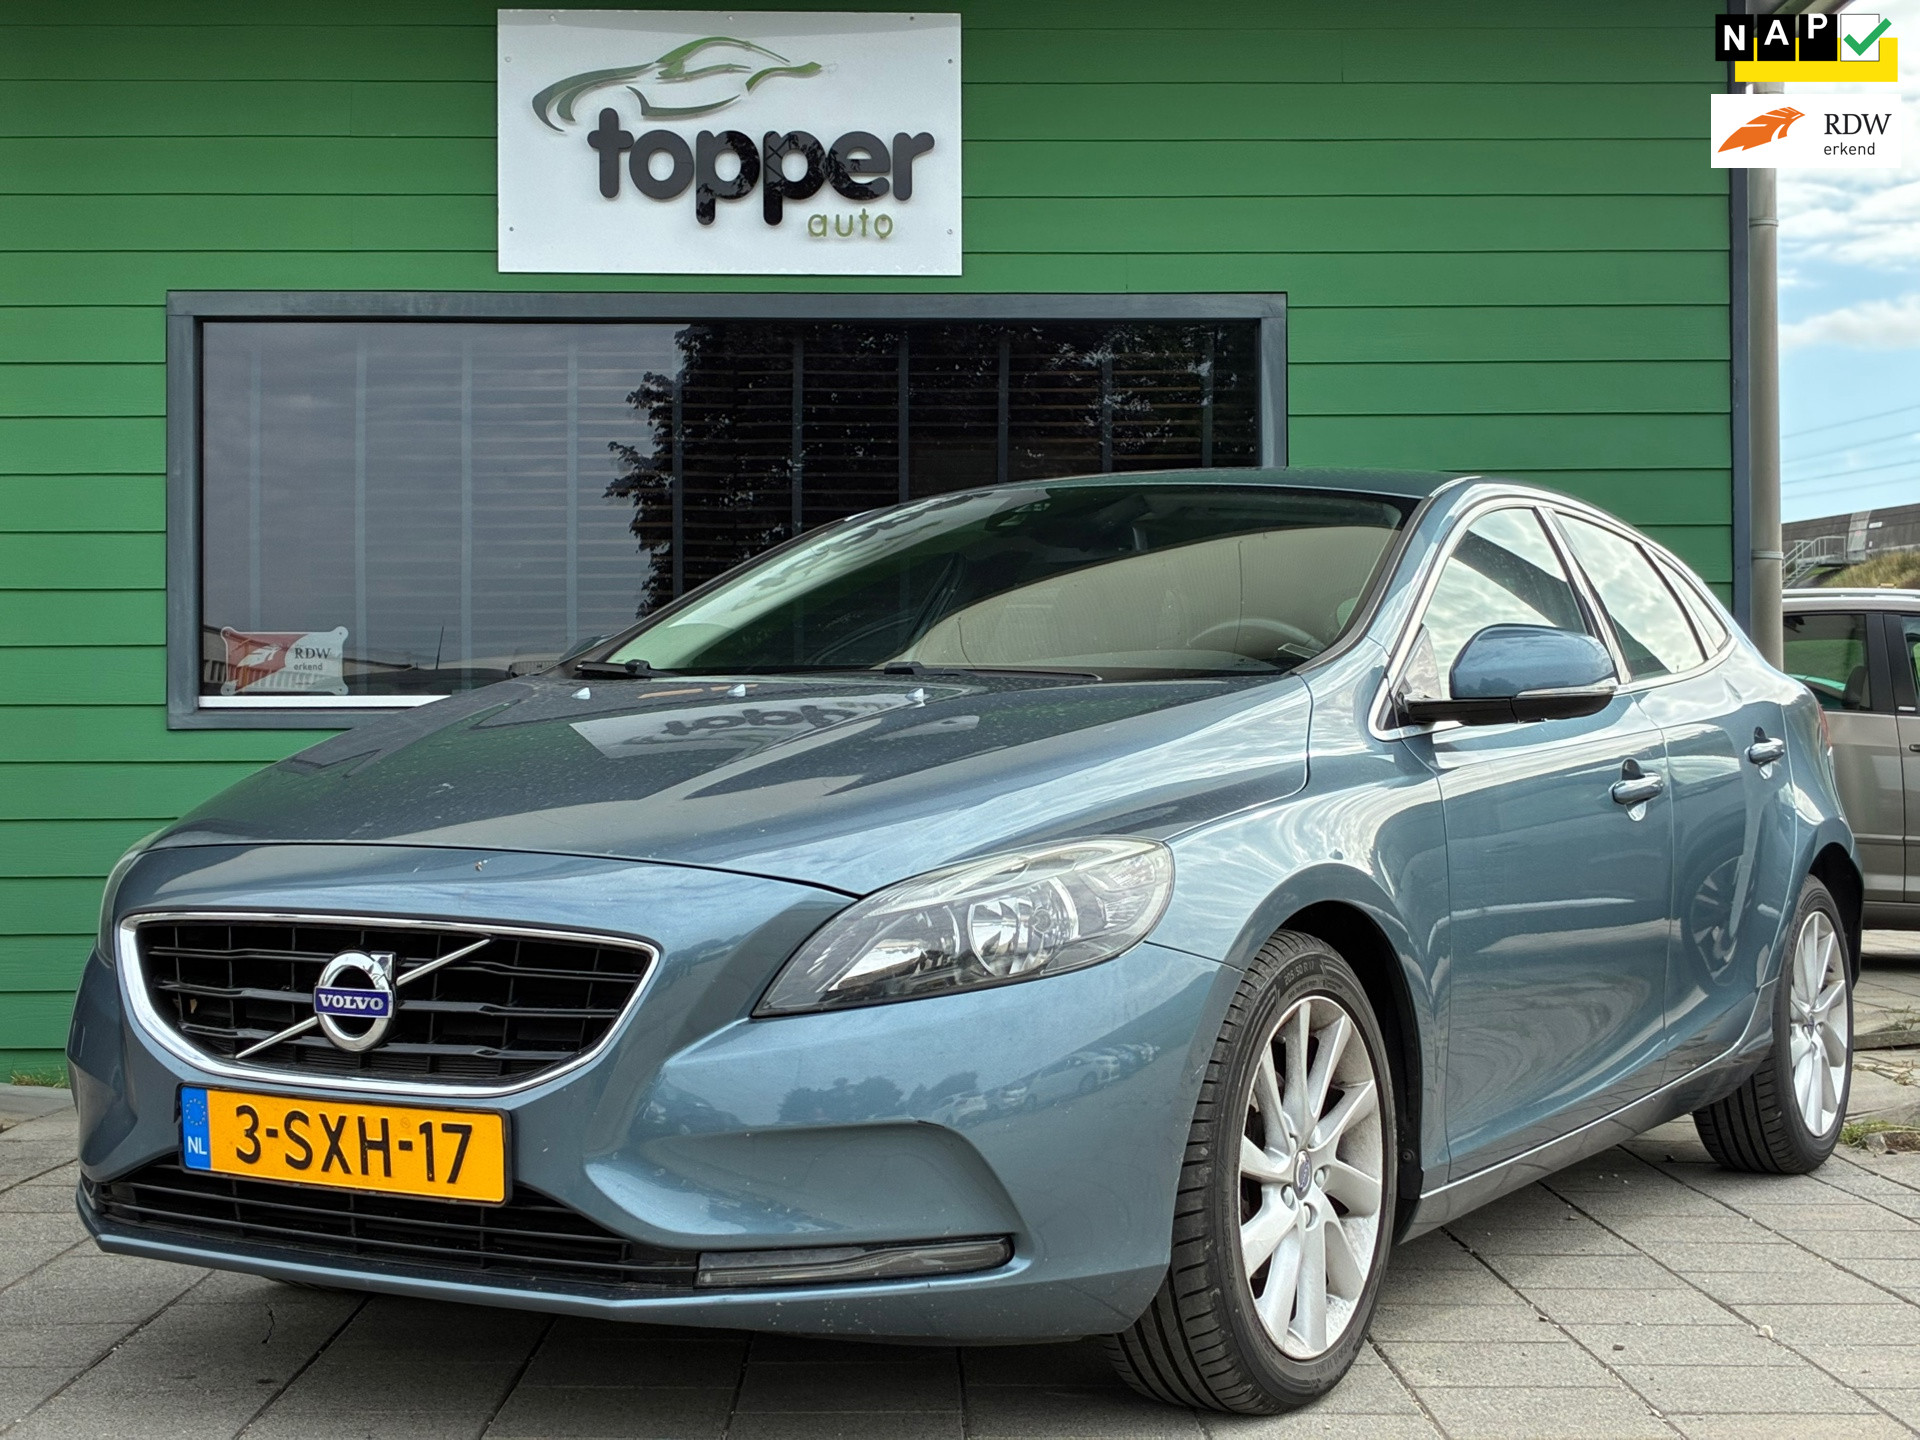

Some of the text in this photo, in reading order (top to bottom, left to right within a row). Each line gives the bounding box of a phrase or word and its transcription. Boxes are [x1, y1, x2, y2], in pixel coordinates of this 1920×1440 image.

[587, 107, 936, 226] topper
[807, 208, 894, 239] auto
[294, 647, 332, 659] RDW
[293, 662, 323, 671] erkend
[318, 993, 384, 1011] VOLVO
[187, 1135, 208, 1155] NL
[235, 1104, 473, 1184] 3-SXH-17
